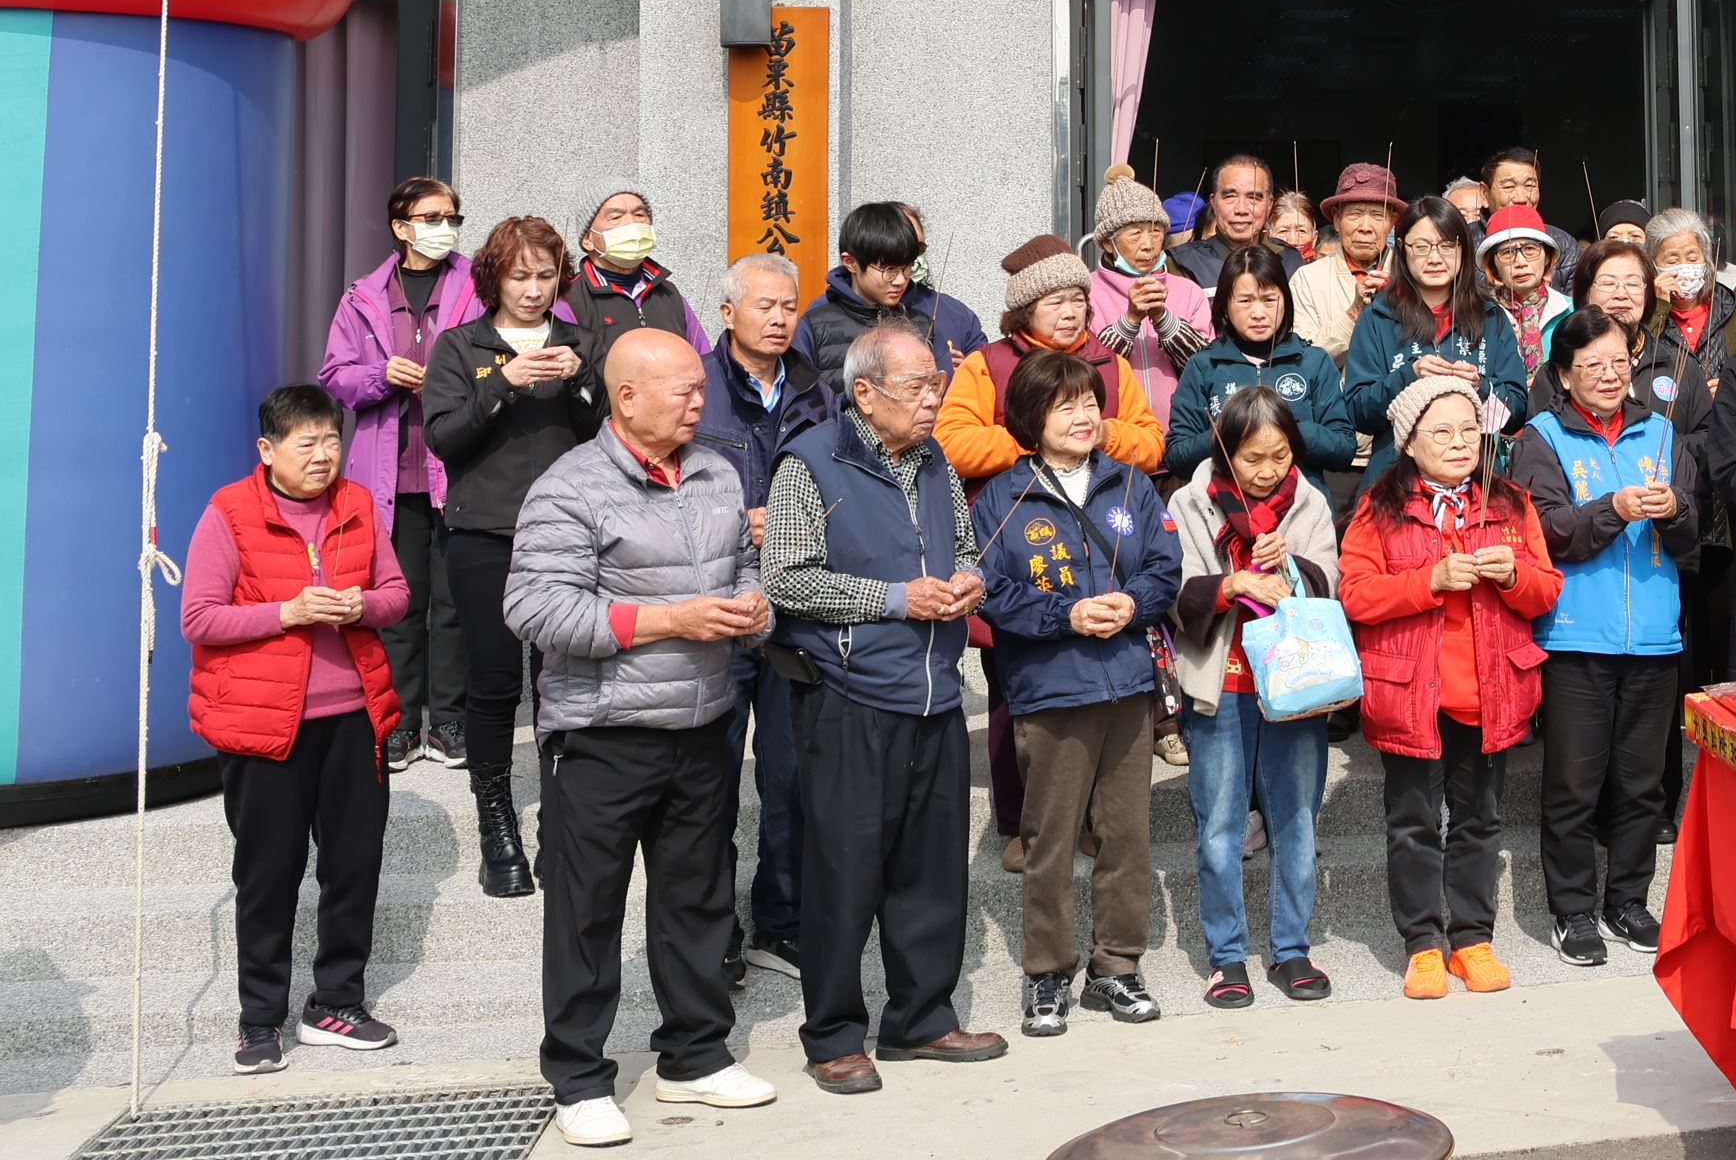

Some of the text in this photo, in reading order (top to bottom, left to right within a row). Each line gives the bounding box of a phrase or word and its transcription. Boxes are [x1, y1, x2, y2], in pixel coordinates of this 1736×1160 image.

[757, 20, 800, 264] 苗栗縣竹南鎮公
[1571, 459, 1593, 506] 吳麗
[1050, 542, 1075, 587] 議員
